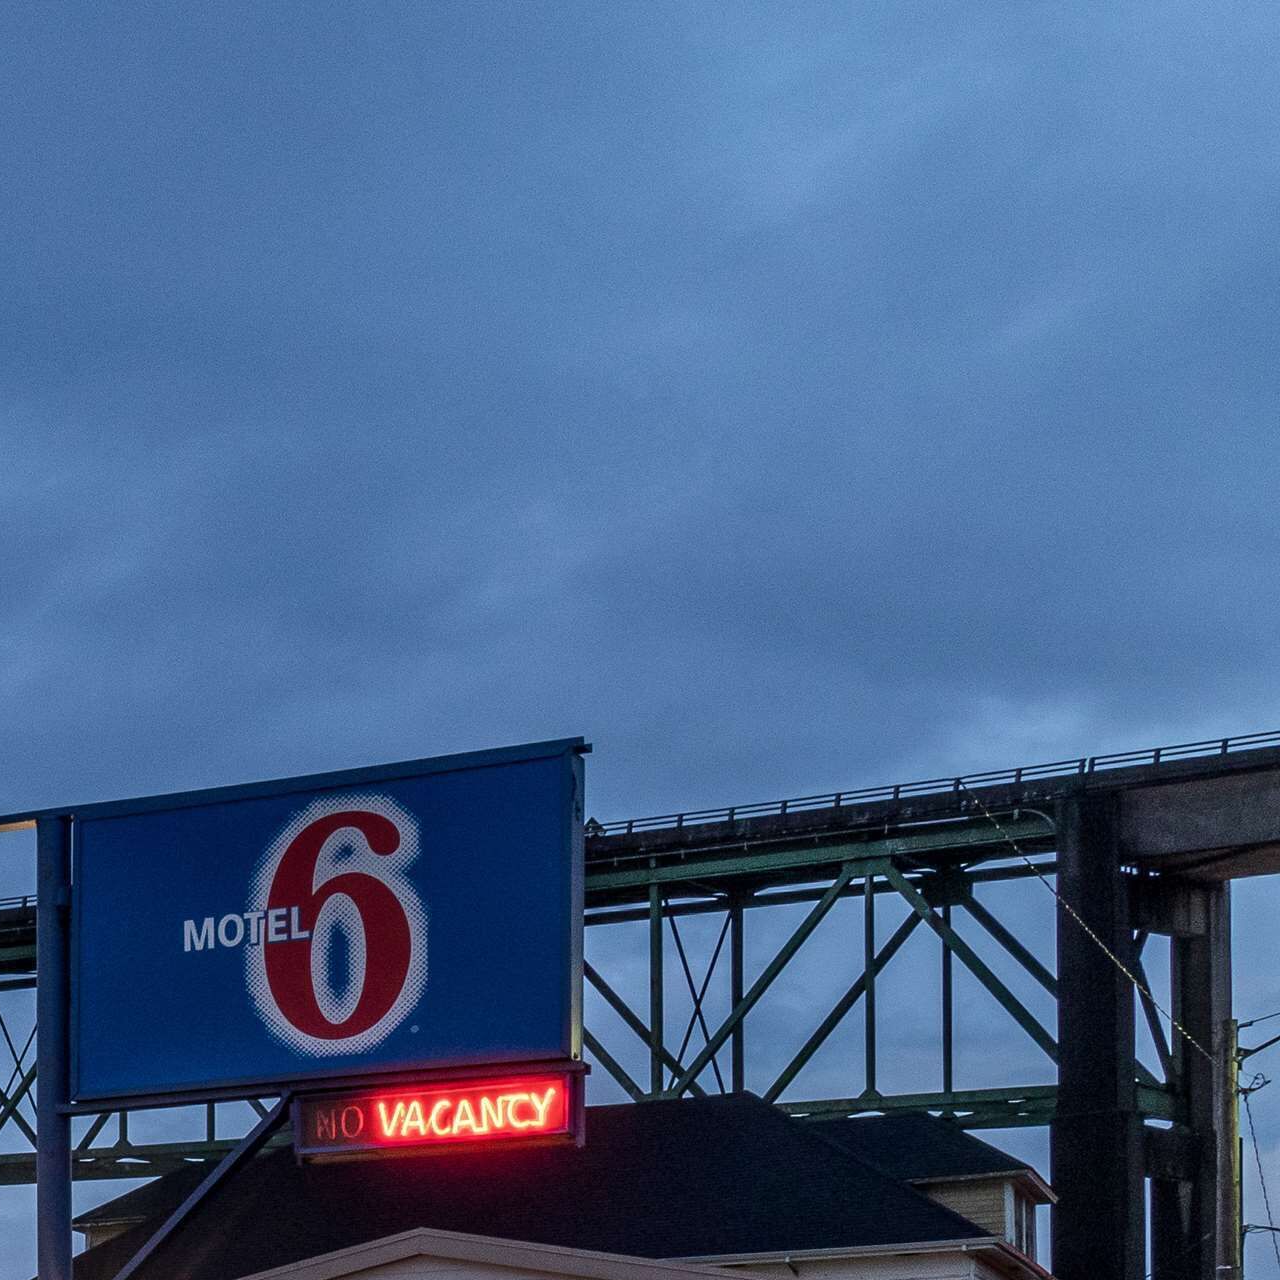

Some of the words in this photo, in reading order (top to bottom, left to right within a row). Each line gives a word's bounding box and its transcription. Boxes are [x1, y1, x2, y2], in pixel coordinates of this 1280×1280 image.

[183, 906, 310, 952] MOTEL
[263, 809, 413, 1041] 6
[316, 1105, 364, 1139] NO
[378, 1087, 556, 1137] VACANCY
